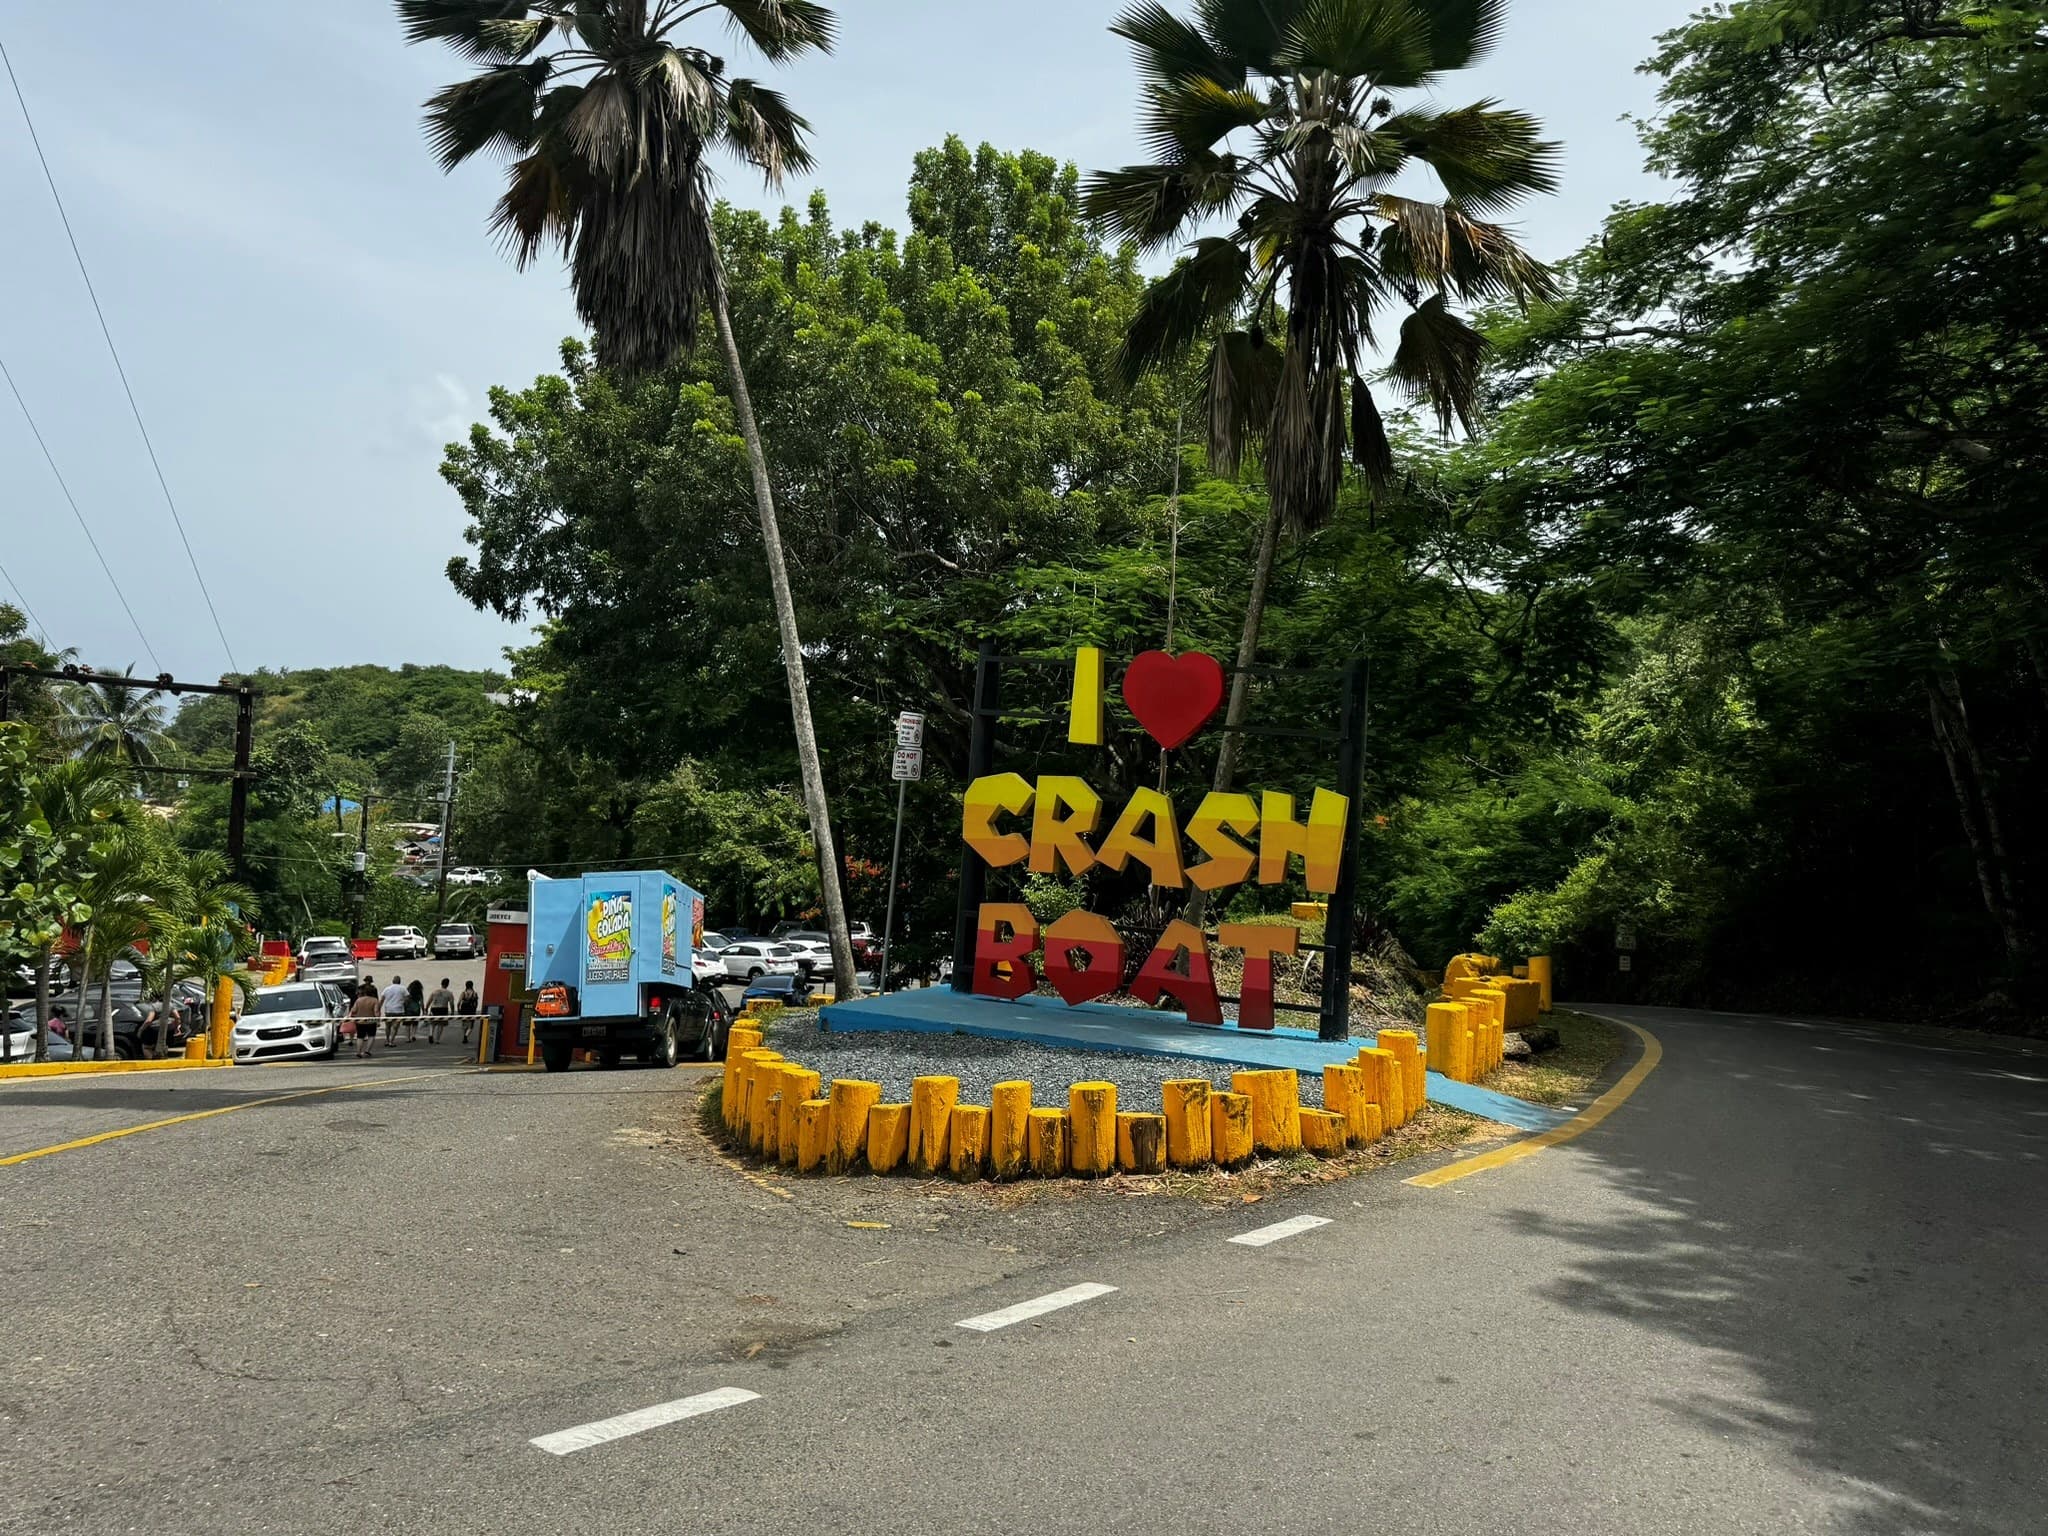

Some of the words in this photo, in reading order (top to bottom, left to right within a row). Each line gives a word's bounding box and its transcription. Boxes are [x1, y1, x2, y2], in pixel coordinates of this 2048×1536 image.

[1068, 647, 1105, 746] I
[906, 752, 917, 760] NOT
[962, 772, 1349, 894] CRASH
[597, 911, 629, 938] COLADA
[602, 895, 623, 916] PIÑA
[972, 902, 1299, 1031] BOAT
